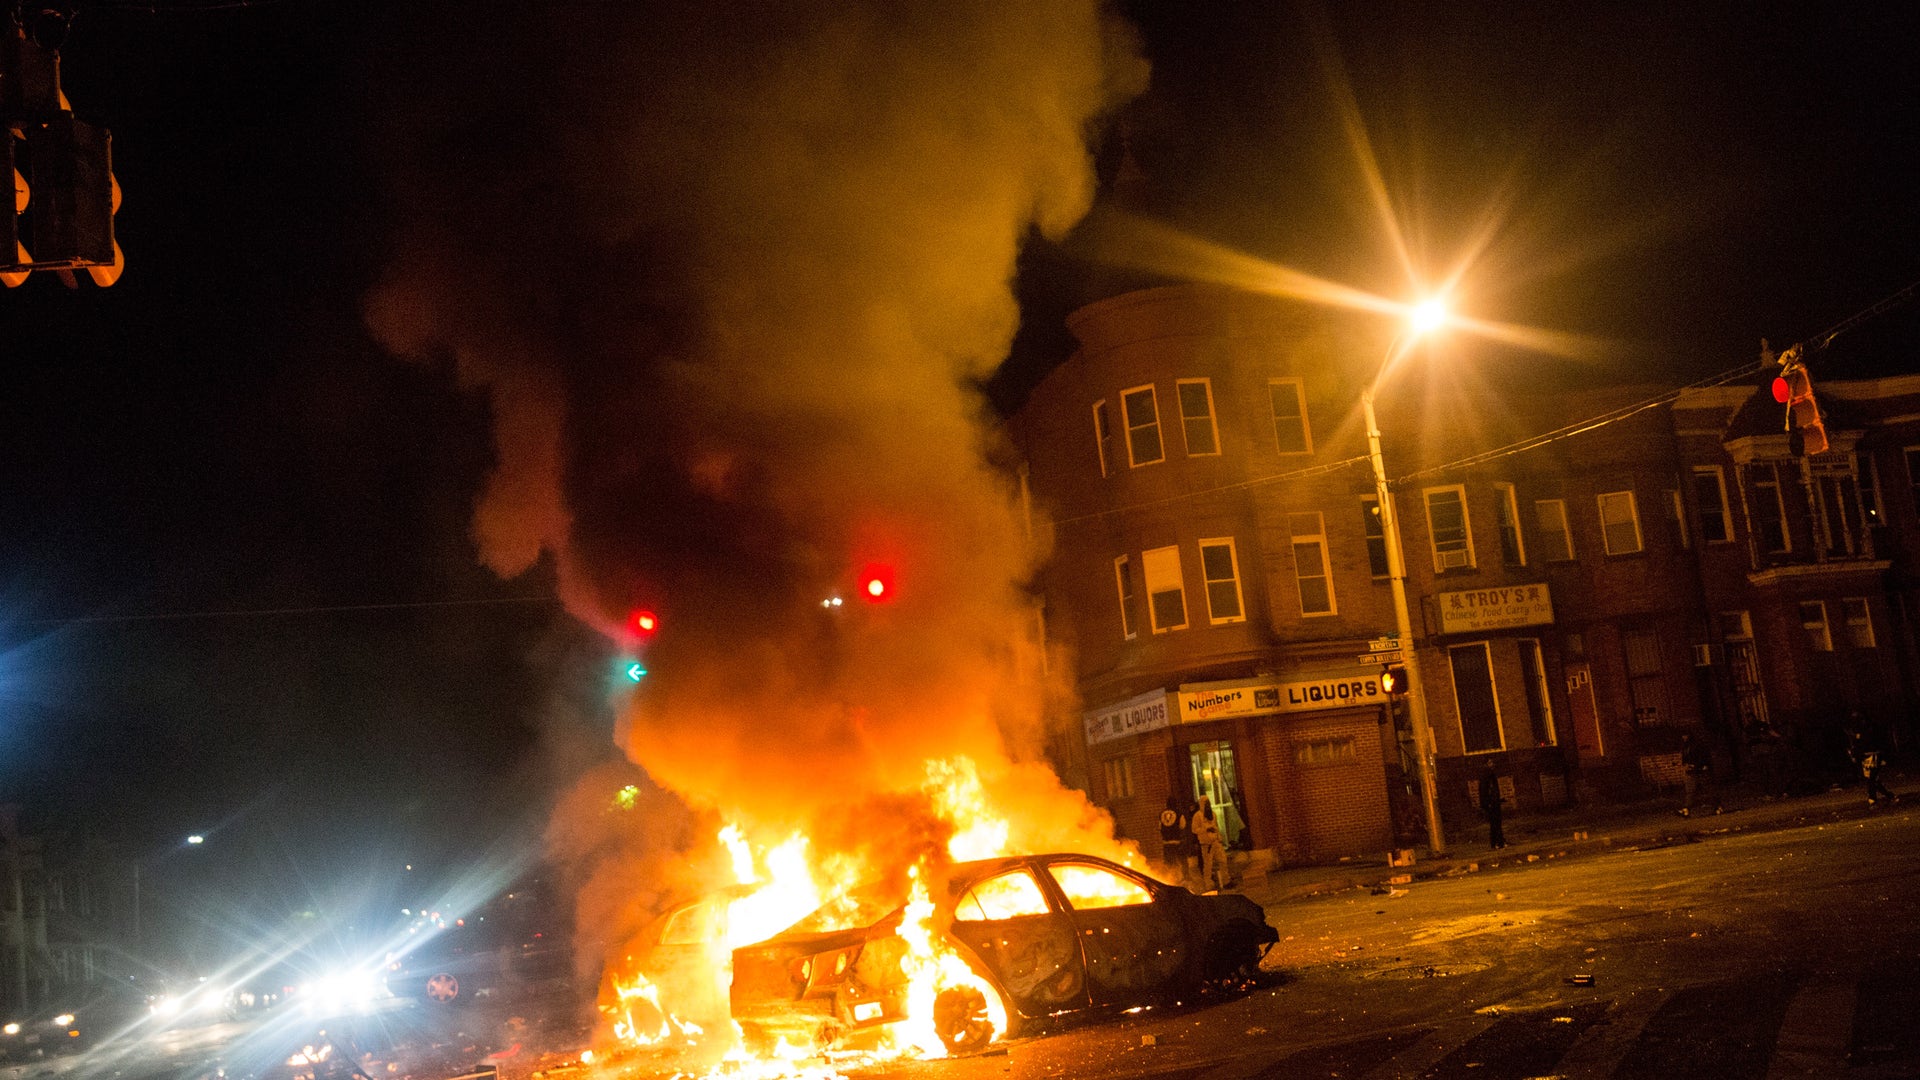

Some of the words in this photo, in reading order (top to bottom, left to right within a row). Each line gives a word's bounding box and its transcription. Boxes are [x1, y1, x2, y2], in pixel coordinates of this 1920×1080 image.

[1466, 588, 1525, 607] TROY'S
[1445, 609, 1477, 621] Chinese
[1483, 606, 1502, 617] Food
[1506, 604, 1530, 616] Carry
[1188, 691, 1242, 711] Numbers
[1195, 690, 1215, 700] The
[1289, 680, 1378, 704] LIQUORS
[1126, 703, 1165, 728] LIQUORS
[1199, 702, 1232, 718] Game
